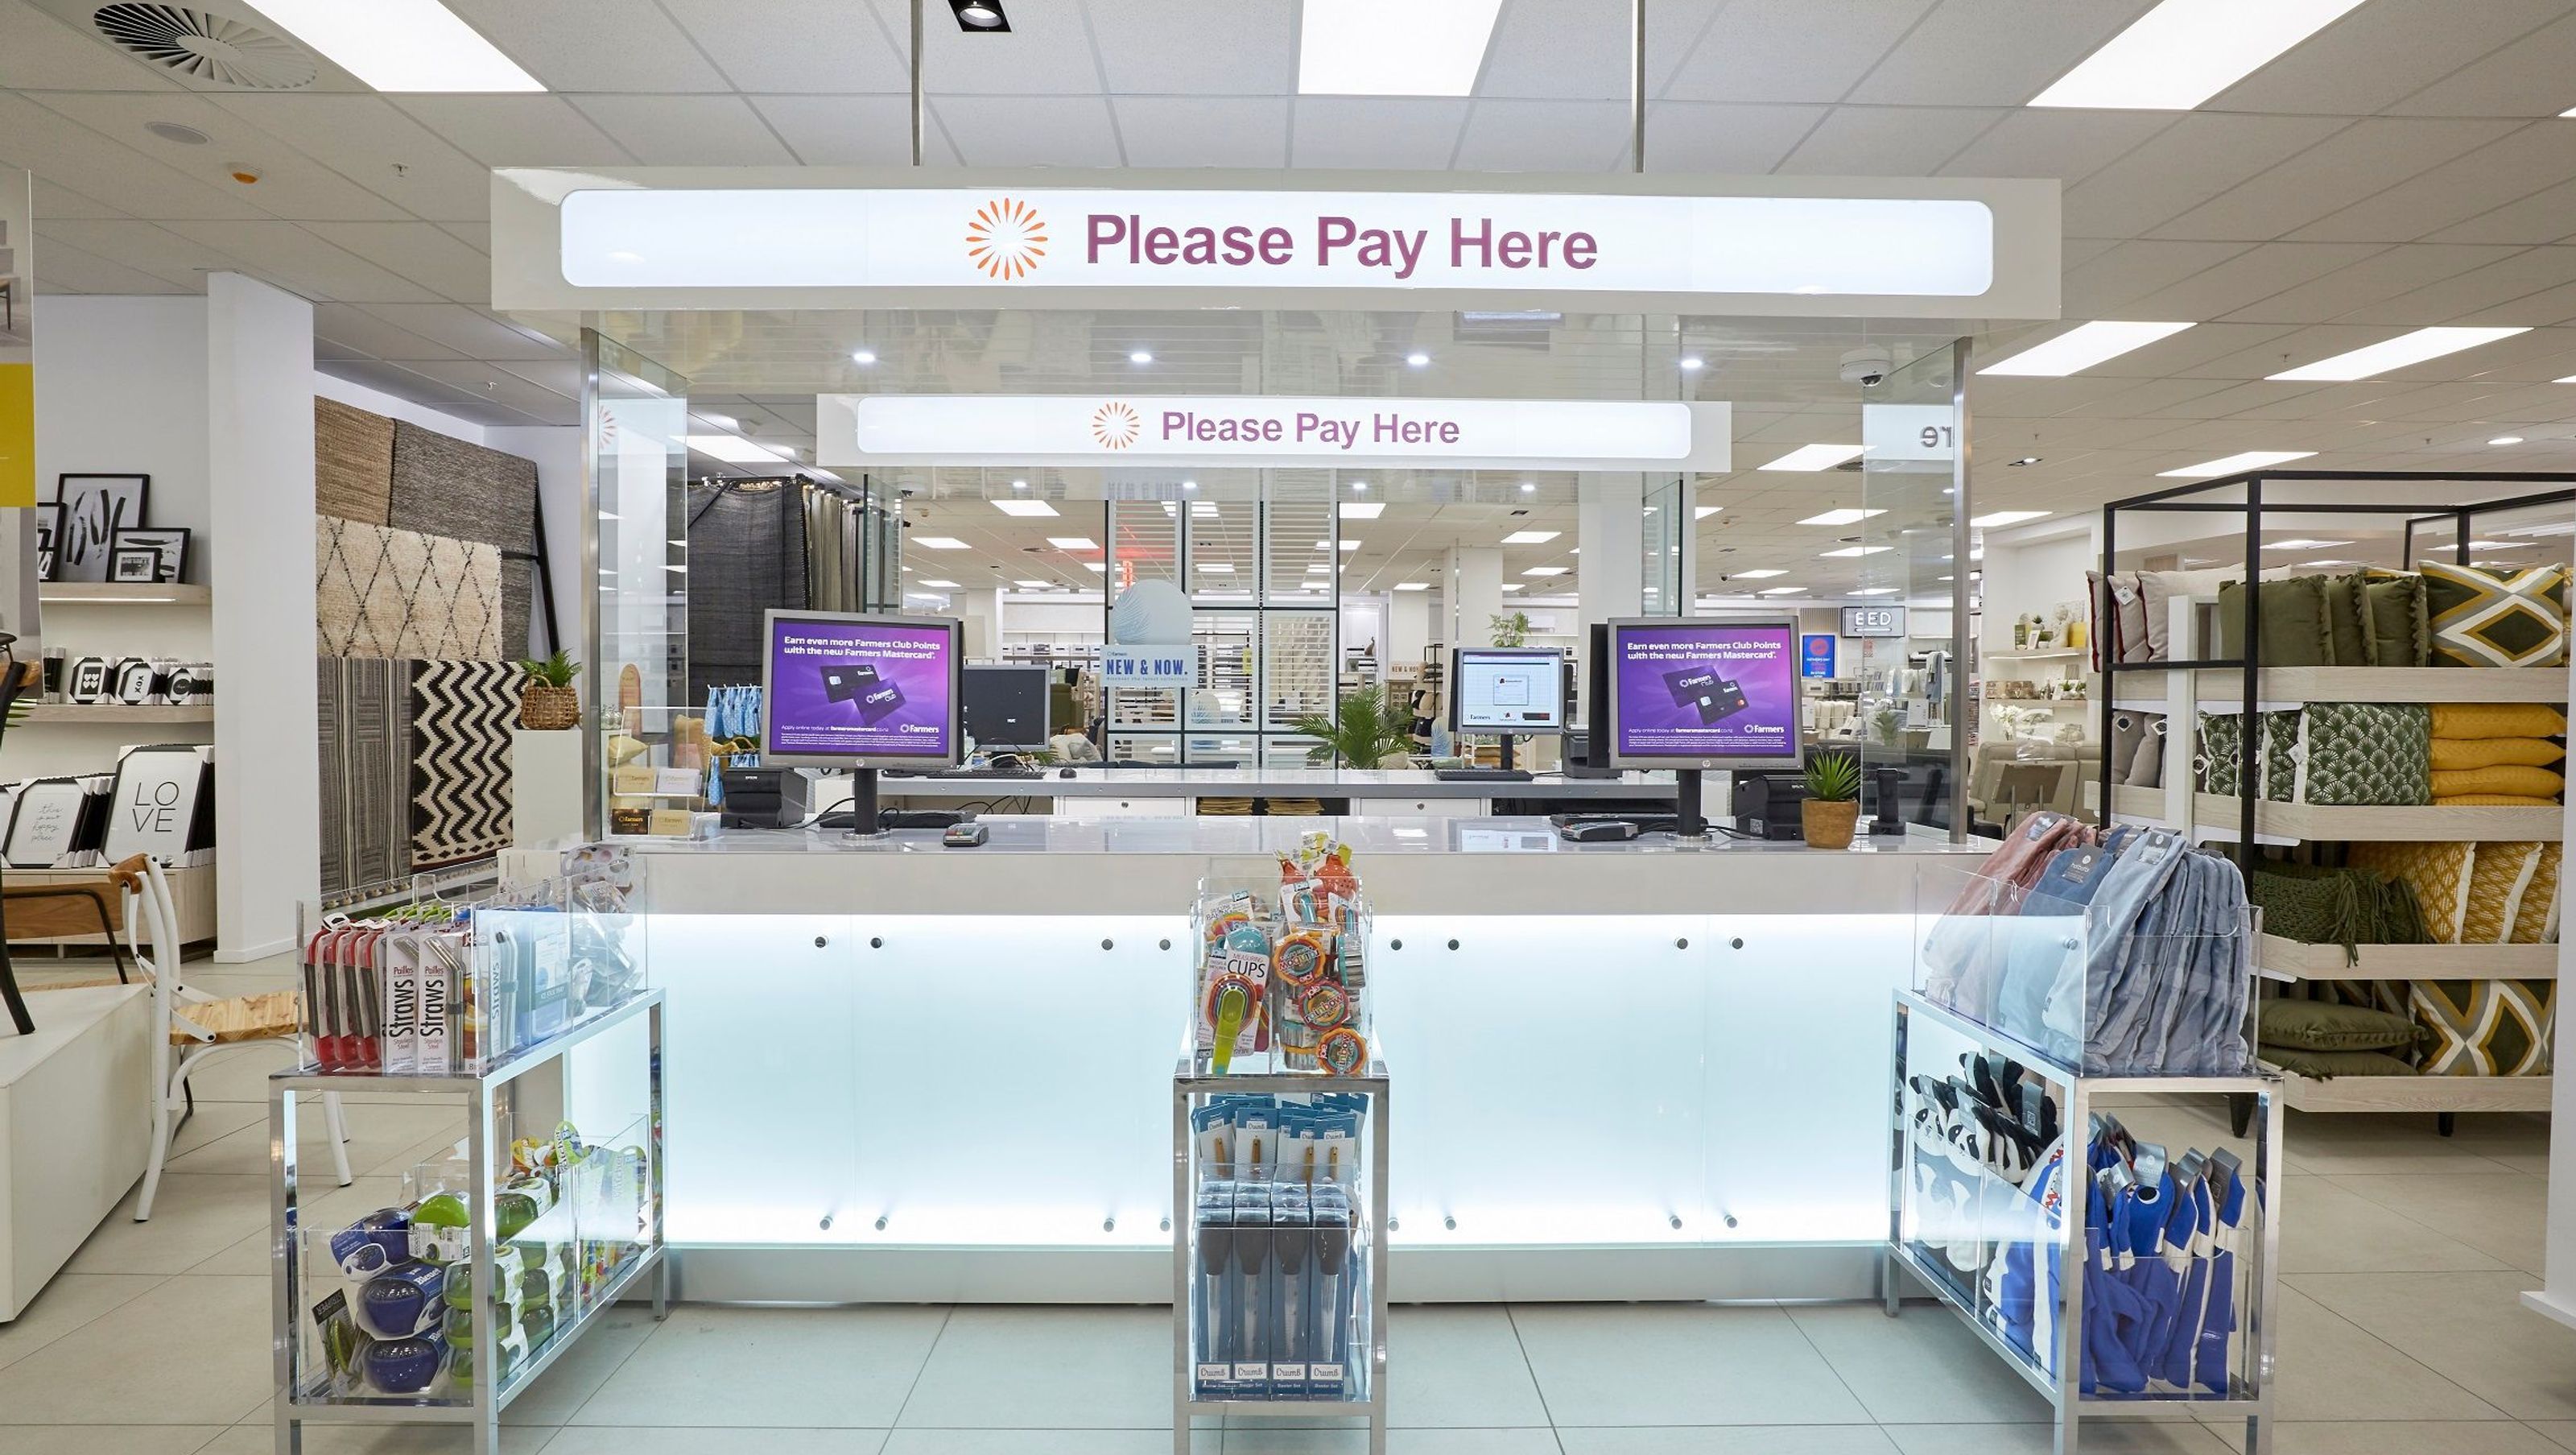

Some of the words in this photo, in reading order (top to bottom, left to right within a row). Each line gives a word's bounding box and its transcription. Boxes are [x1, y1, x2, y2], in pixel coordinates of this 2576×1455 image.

[1088, 214, 1294, 267] Please
[1318, 216, 1428, 279] Pay
[1451, 217, 1598, 270] Here
[1162, 411, 1283, 442] Please
[1296, 412, 1360, 450] Pay
[1373, 413, 1460, 444] Here
[784, 636, 805, 644] Earn
[855, 639, 891, 647] Farmers
[893, 641, 911, 649] Club
[913, 642, 940, 650] Points
[784, 647, 806, 655] with
[807, 647, 822, 655] the
[844, 649, 881, 657] Farmers
[1106, 659, 1134, 675] NEW
[1140, 659, 1148, 675] &
[1154, 659, 1188, 675] NOW.
[1688, 674, 1711, 685] Farmers
[873, 688, 894, 701] Farmers
[910, 725, 939, 733] Farmers
[1754, 725, 1784, 734] Farmers
[134, 781, 180, 806] LO
[132, 808, 176, 833] VE
[394, 966, 414, 974] Pailles
[424, 966, 444, 974] Pailles
[1227, 959, 1266, 978] CUPS
[491, 962, 500, 1020] Straws
[389, 978, 415, 1038] Straws
[419, 979, 444, 1037] Straws
[1304, 994, 1344, 1023] rainbow
[1200, 1368, 1226, 1376] Crumb
[1238, 1366, 1263, 1376] Crumb
[1276, 1368, 1302, 1376] Crumb
[1314, 1368, 1338, 1377] Crumb
